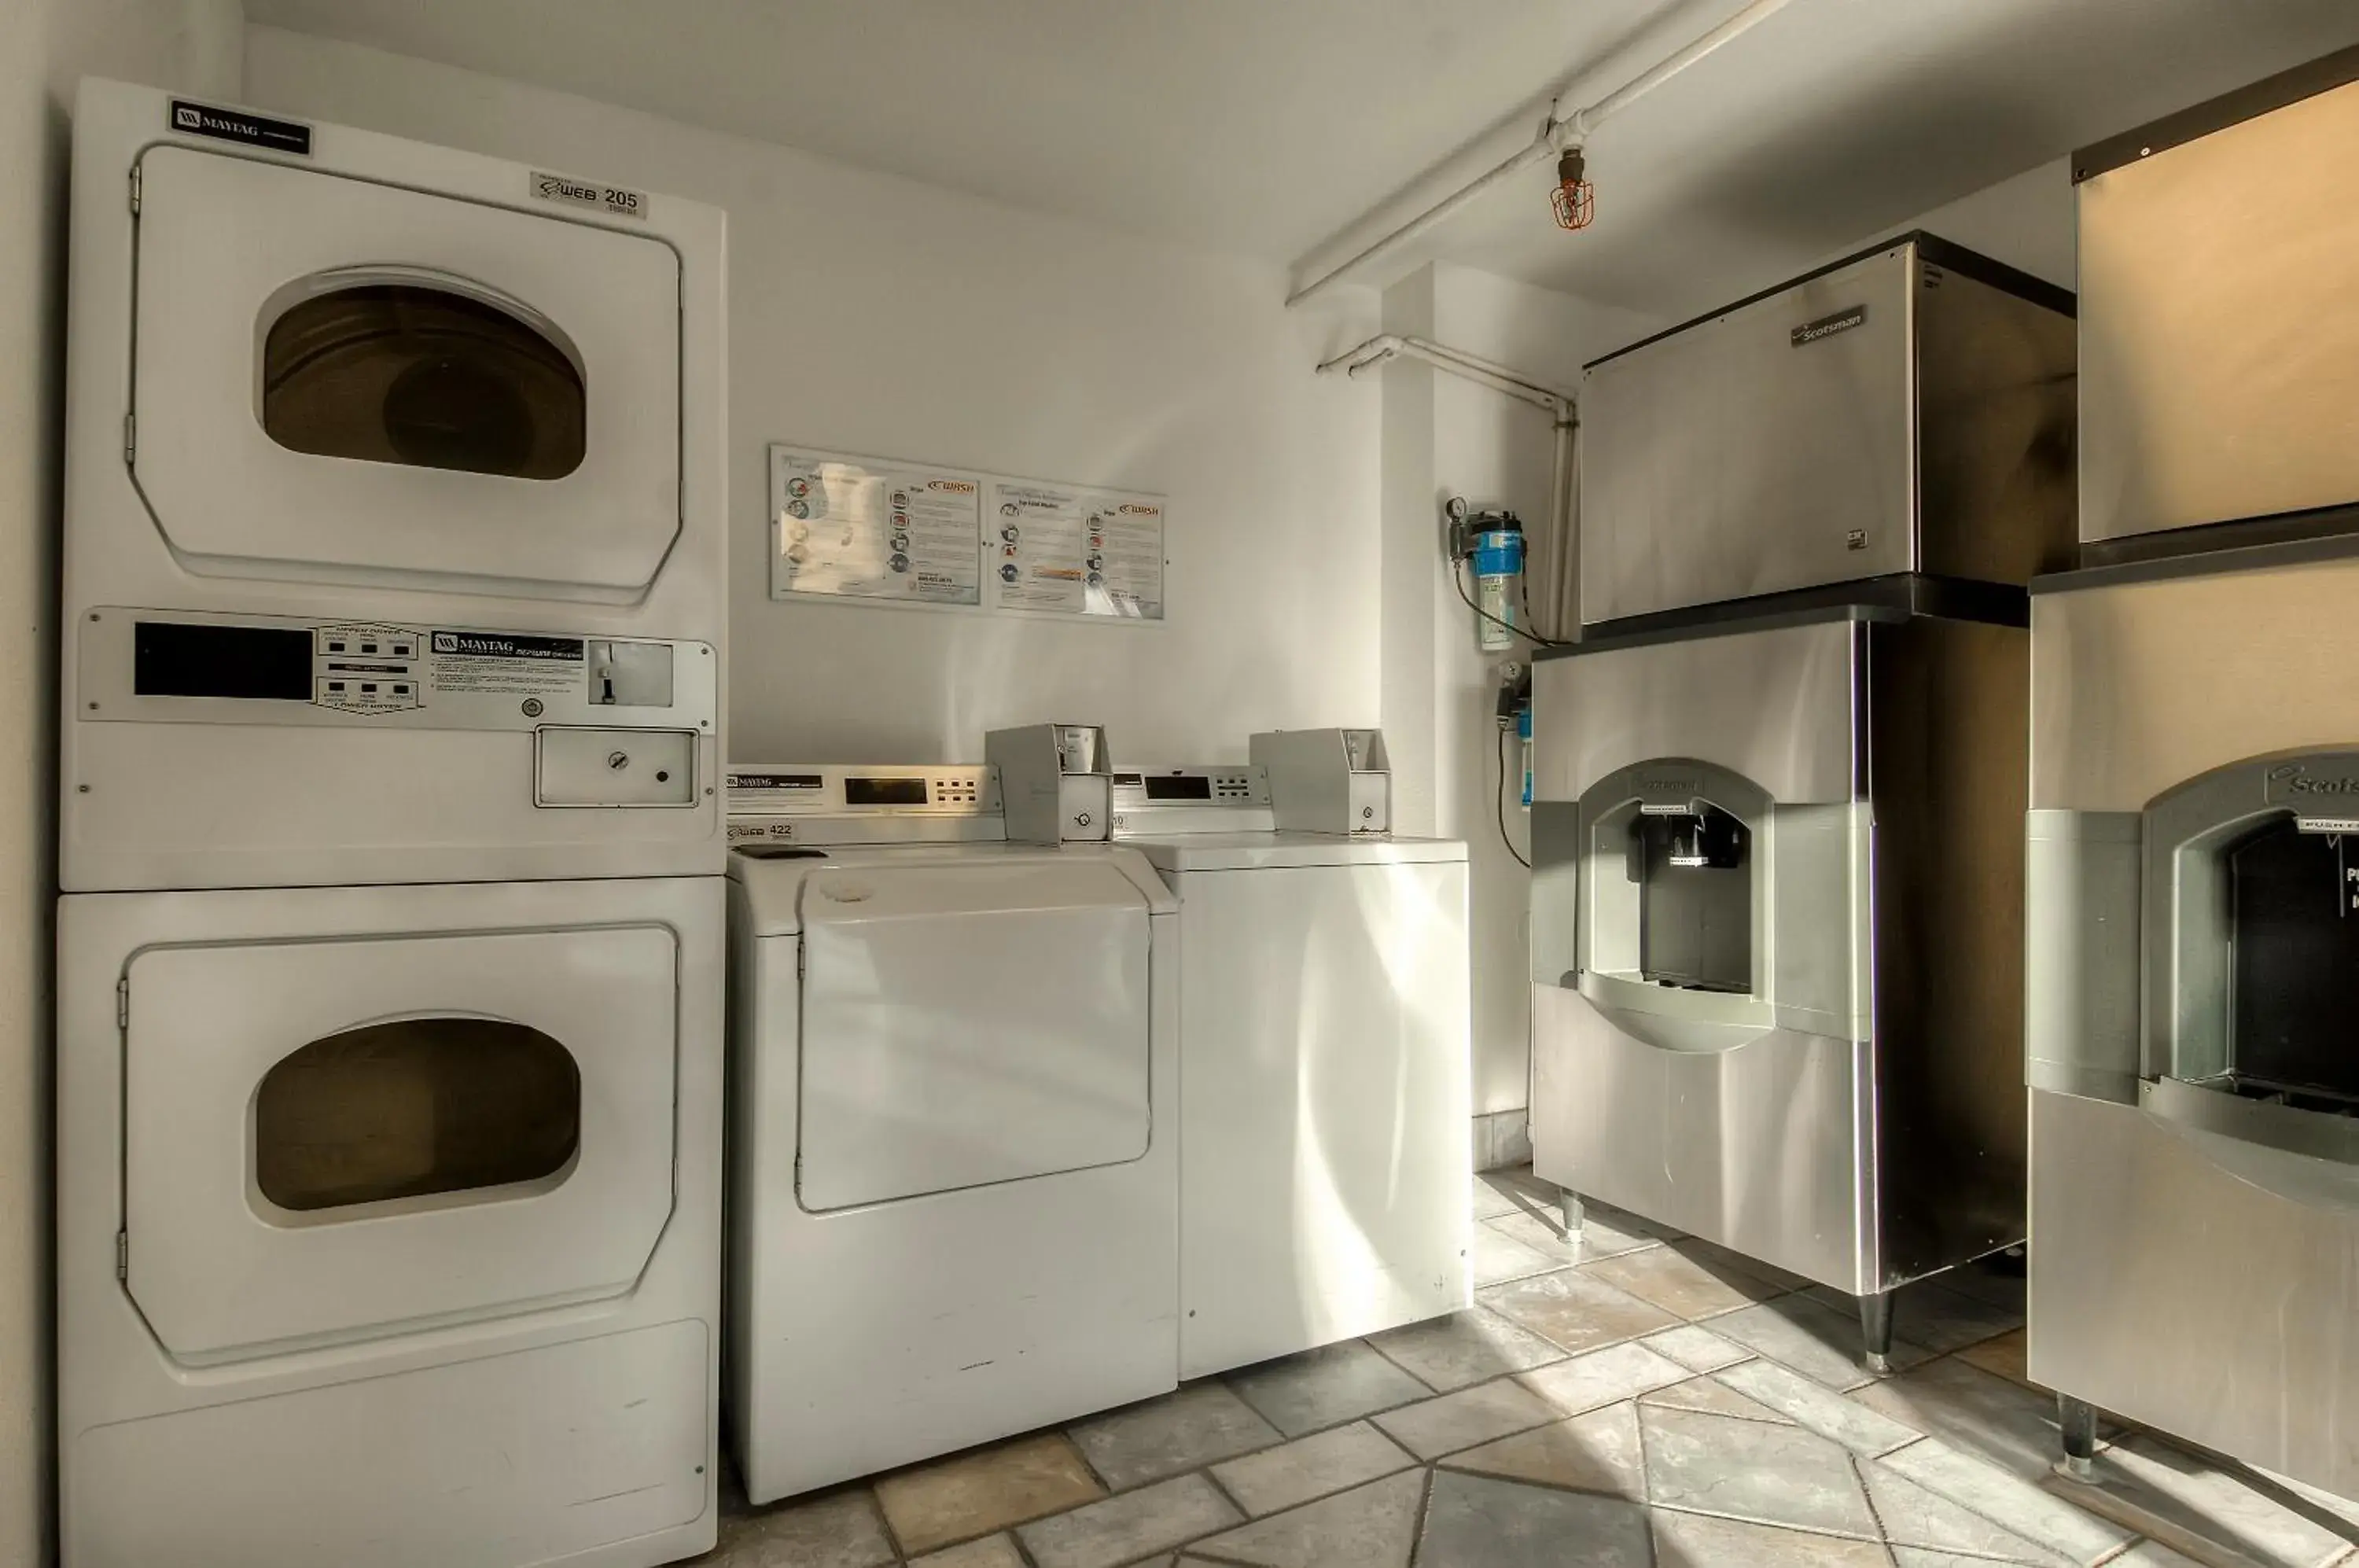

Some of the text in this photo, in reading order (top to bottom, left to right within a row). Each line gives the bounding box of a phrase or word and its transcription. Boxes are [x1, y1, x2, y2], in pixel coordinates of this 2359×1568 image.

[202, 116, 259, 137] MAYTAG
[605, 188, 639, 208] 205
[1803, 315, 1861, 340] Scotsman
[459, 639, 513, 652] MAYTAG
[770, 824, 792, 834] 422
